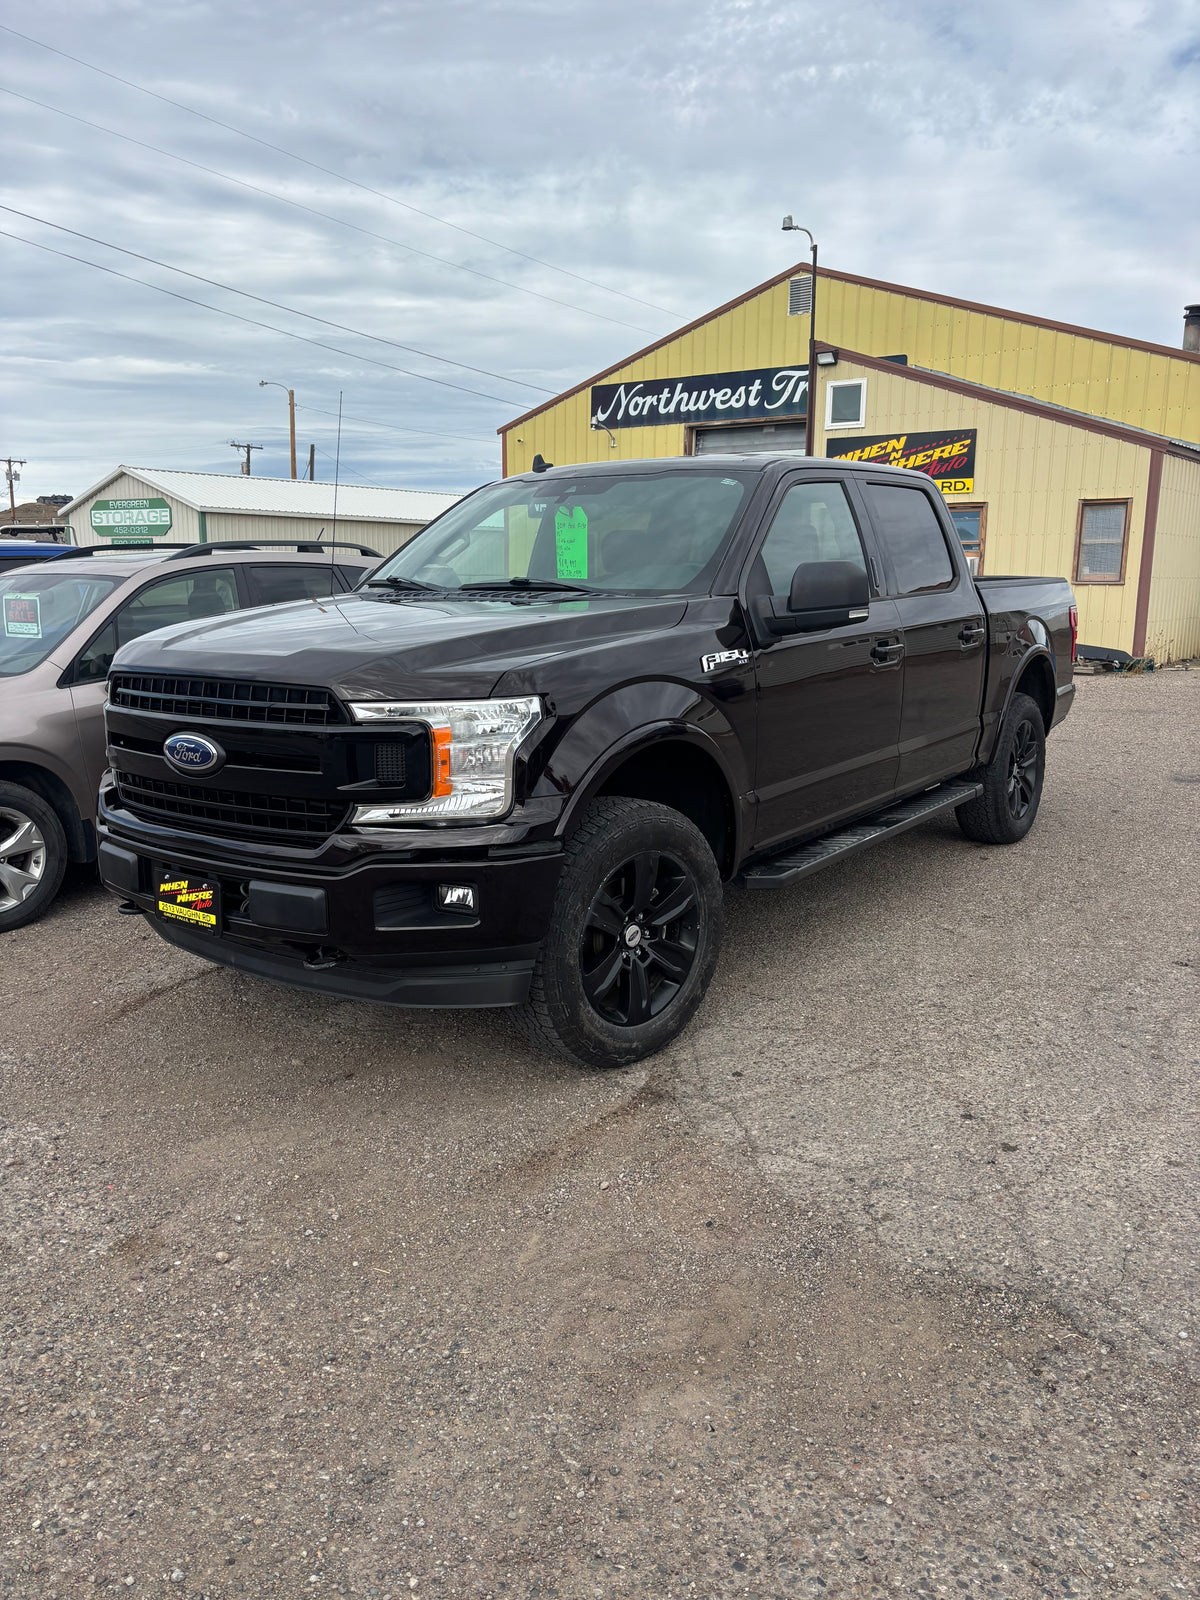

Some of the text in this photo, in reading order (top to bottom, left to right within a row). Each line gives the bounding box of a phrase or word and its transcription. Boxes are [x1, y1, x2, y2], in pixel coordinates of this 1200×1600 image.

[597, 379, 762, 421] Northwest
[889, 450, 903, 461] N
[919, 456, 968, 477] Auto
[941, 481, 970, 492] RD.
[109, 500, 149, 509] EVERGREEN
[92, 510, 169, 524] STORAGE
[113, 526, 149, 534] 452-0312
[11, 600, 29, 611] FOR
[9, 611, 35, 622] SALE
[174, 742, 203, 762] Ford
[160, 880, 188, 892] WHEN
[176, 890, 213, 903] WHERE
[191, 899, 213, 911] Auto
[175, 905, 201, 920] VAUGHN
[202, 913, 213, 923] RD.
